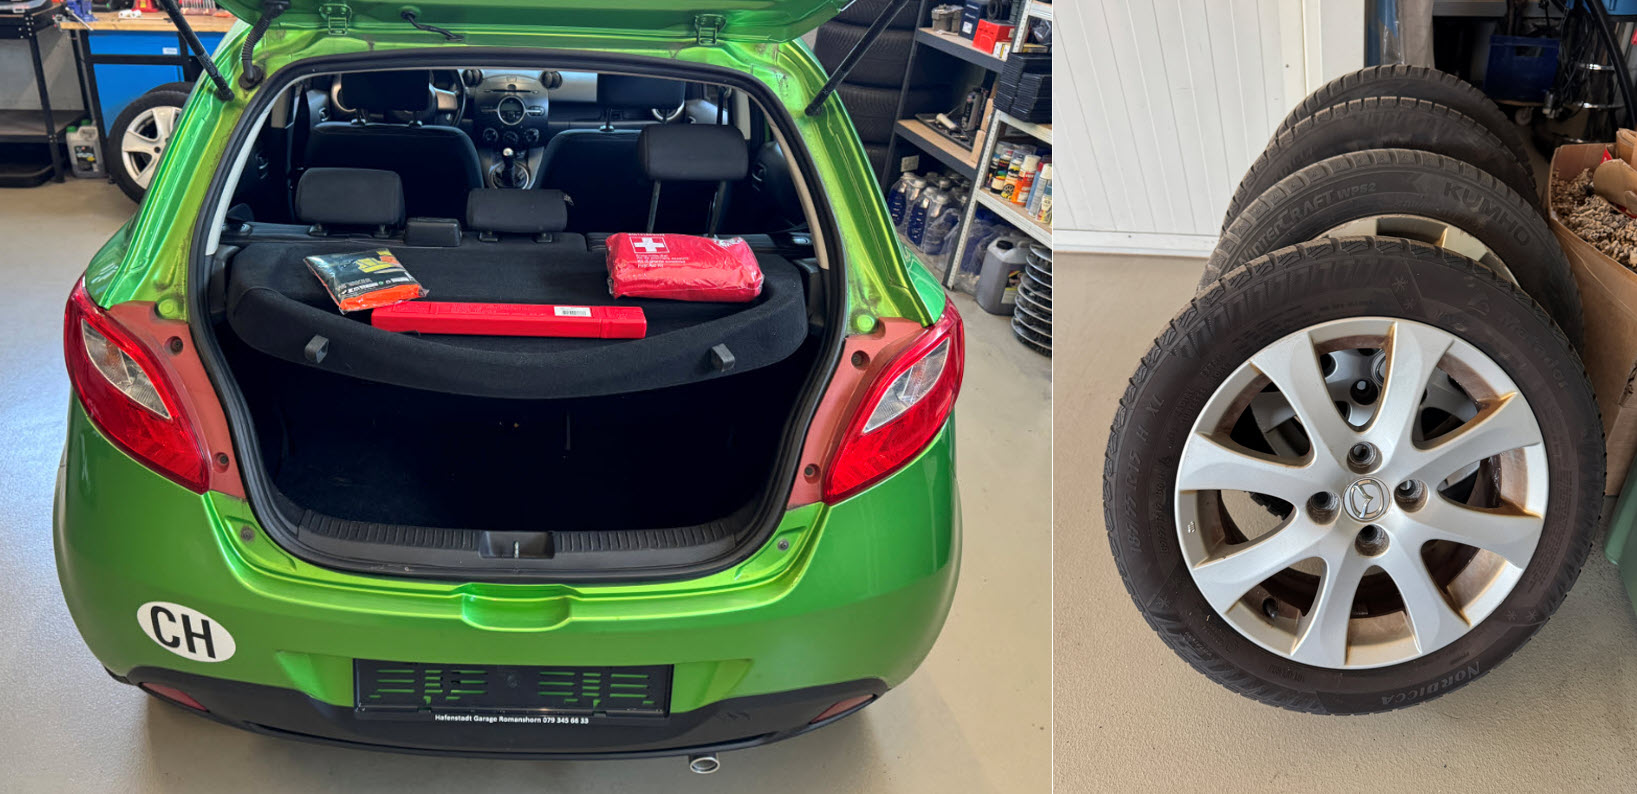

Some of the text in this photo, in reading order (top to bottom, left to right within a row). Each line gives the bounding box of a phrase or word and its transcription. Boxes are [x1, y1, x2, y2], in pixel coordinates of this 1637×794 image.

[1337, 182, 1377, 199] WPS2
[1444, 182, 1530, 246] KUMHO
[150, 605, 216, 659] CH
[435, 714, 472, 722] Hafenstadt
[473, 715, 498, 724] Garage
[499, 716, 542, 724] Romanshorn
[543, 716, 555, 724] 079
